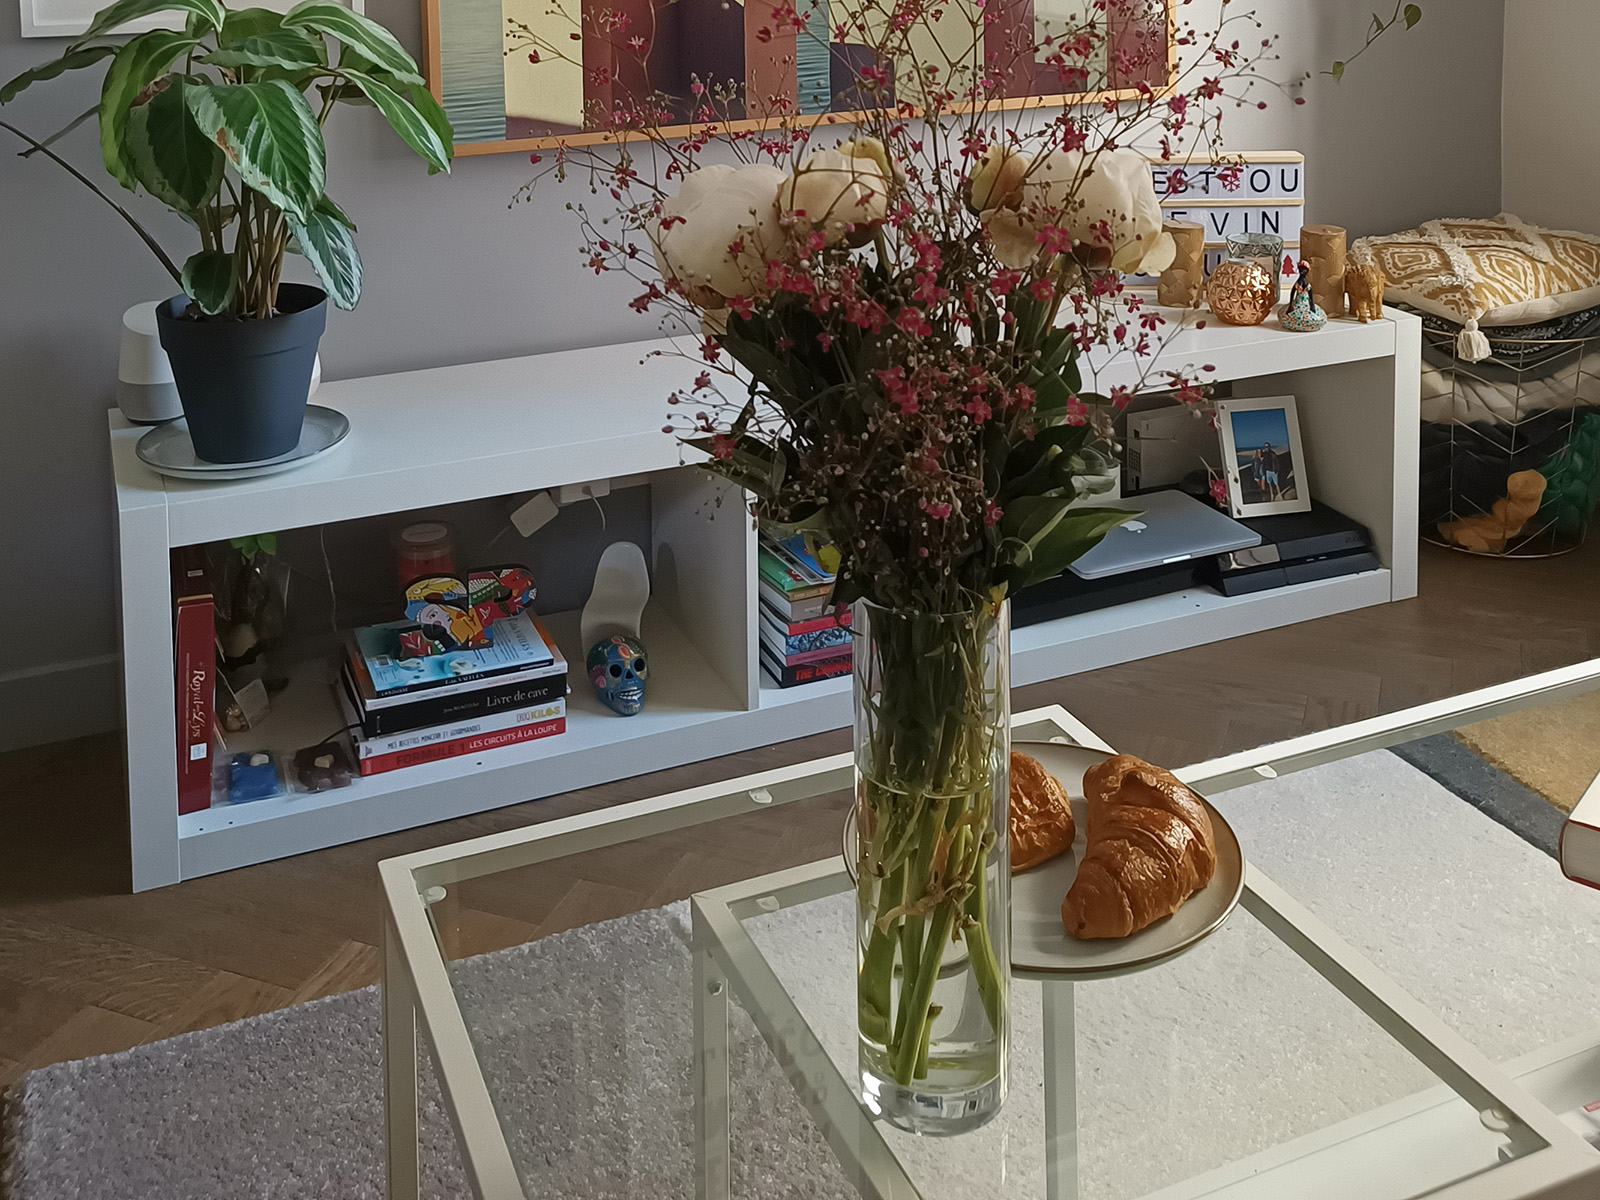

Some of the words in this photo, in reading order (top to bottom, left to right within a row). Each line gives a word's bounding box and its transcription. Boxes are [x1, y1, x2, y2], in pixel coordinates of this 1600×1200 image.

[1250, 168, 1298, 193] OU
[1211, 211, 1279, 236] VIN
[486, 695, 512, 707] Livre
[513, 690, 526, 701] de
[527, 687, 549, 699] cave
[469, 739, 483, 749] LES
[484, 732, 516, 746] CIRCUITS
[517, 730, 523, 739] À
[523, 728, 533, 737] LA
[534, 723, 557, 735] LOUPE
[396, 743, 455, 766] FORMULE
